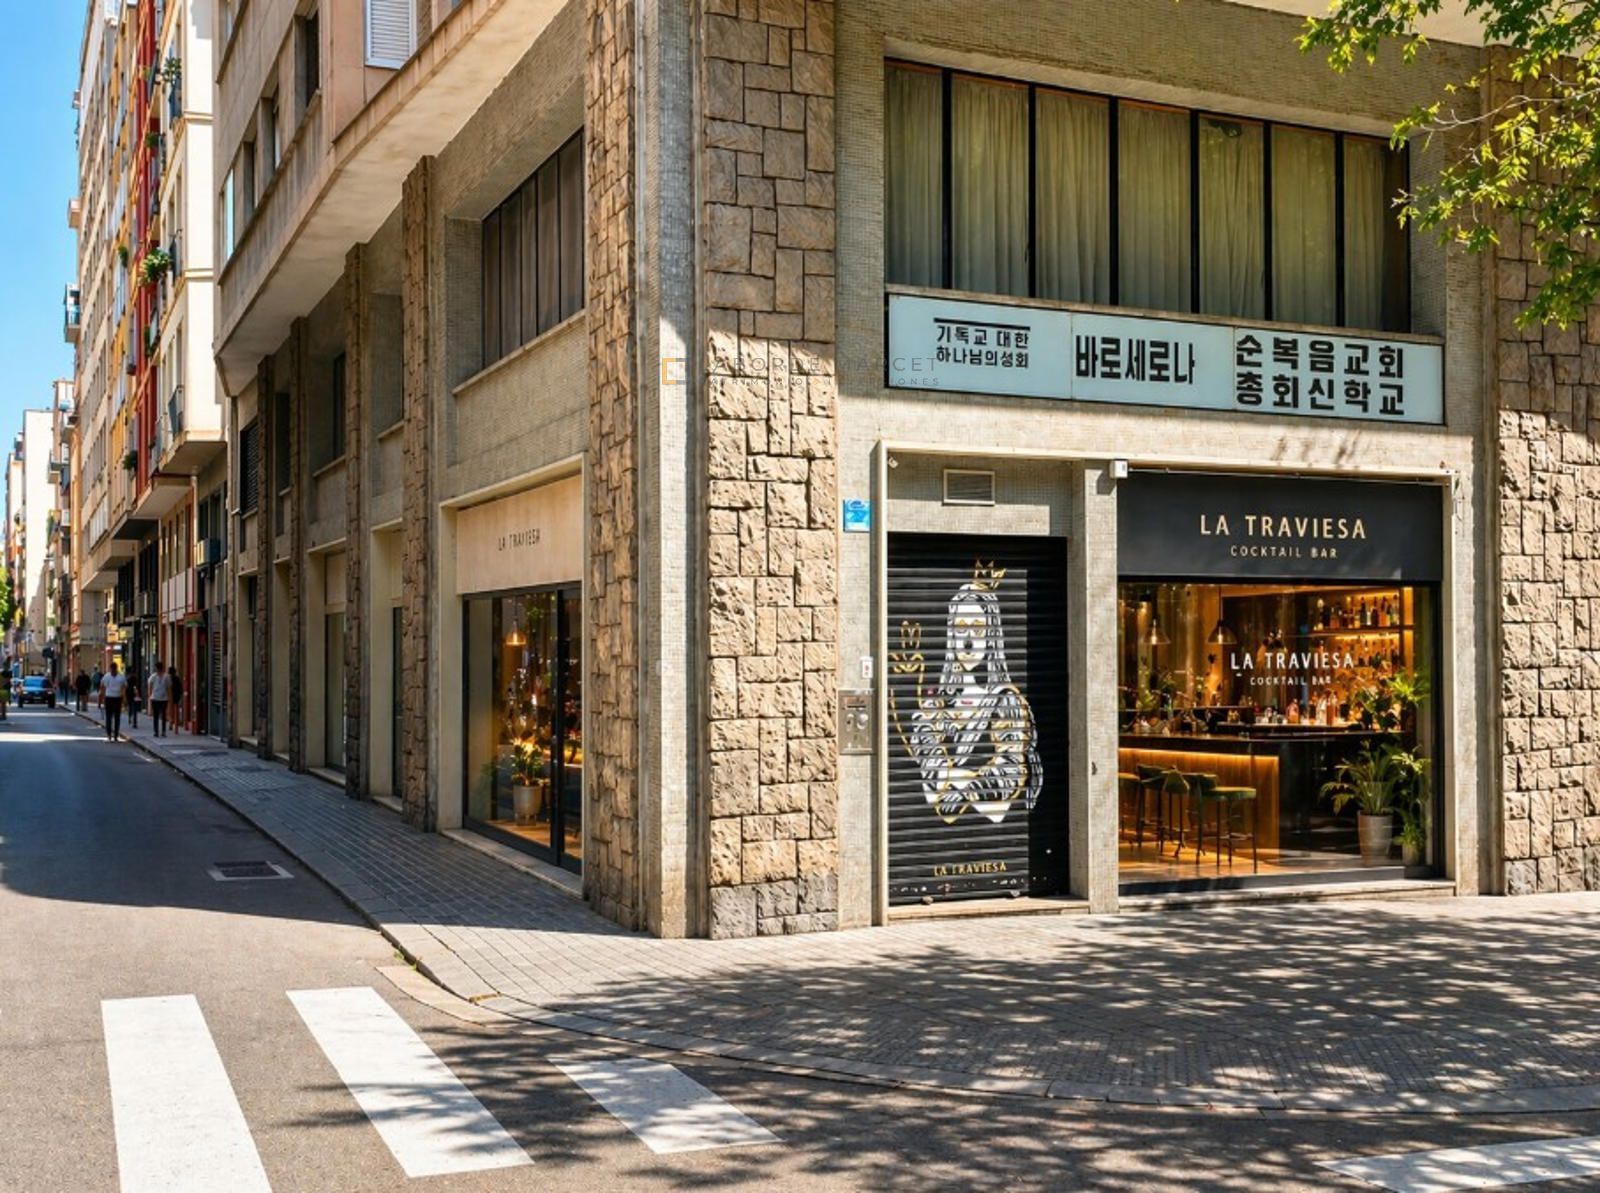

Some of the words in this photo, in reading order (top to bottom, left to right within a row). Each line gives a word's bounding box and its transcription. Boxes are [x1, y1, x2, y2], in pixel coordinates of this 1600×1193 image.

[996, 330, 1029, 349] 대한
[936, 345, 1029, 369] 하나님의성회
[1076, 334, 1196, 385] 바로세로나
[1236, 371, 1405, 416] 총회신학교
[1200, 514, 1231, 536] LA
[1245, 515, 1367, 540] TRAVIESA
[1230, 545, 1302, 558] COCKTAIL
[1310, 547, 1338, 559] BAR
[1230, 652, 1254, 670] LA
[1264, 652, 1354, 670] TRAVIESA
[1250, 676, 1307, 686] COCKTAIL
[934, 865, 948, 877] LA
[952, 861, 1007, 875] TRAVIESA
